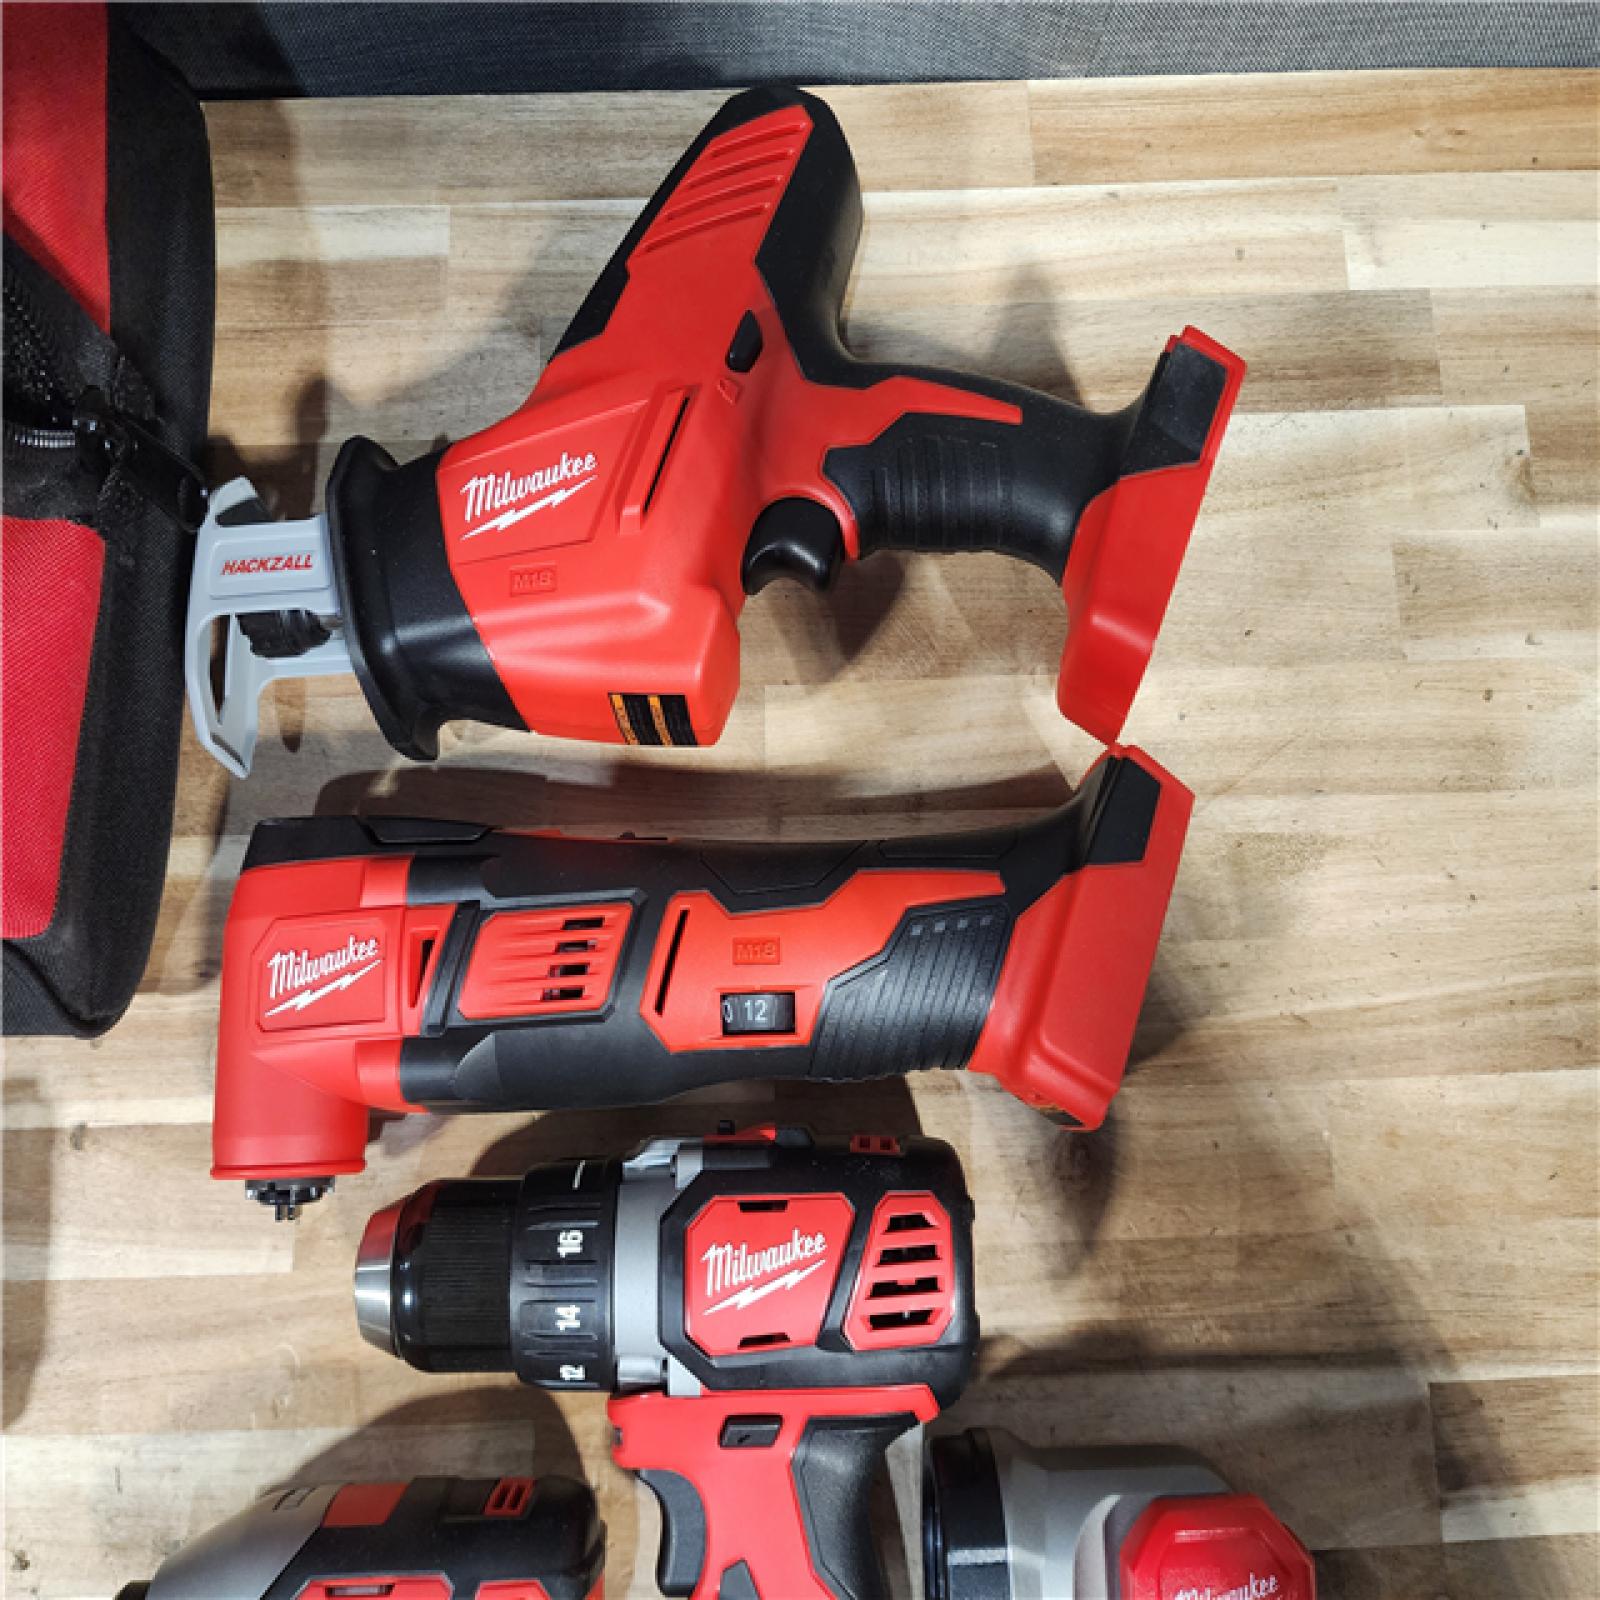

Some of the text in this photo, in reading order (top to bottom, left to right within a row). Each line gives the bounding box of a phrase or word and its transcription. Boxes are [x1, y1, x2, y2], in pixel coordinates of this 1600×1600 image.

[459, 451, 598, 523] Milwaukee
[219, 553, 313, 576] HACKZALL
[736, 942, 776, 961] M18
[267, 934, 379, 1000] Milwaukee
[744, 999, 768, 1023] 12
[557, 1229, 584, 1258] 16
[702, 1227, 827, 1298] Milwaukee
[554, 1304, 582, 1331] 14
